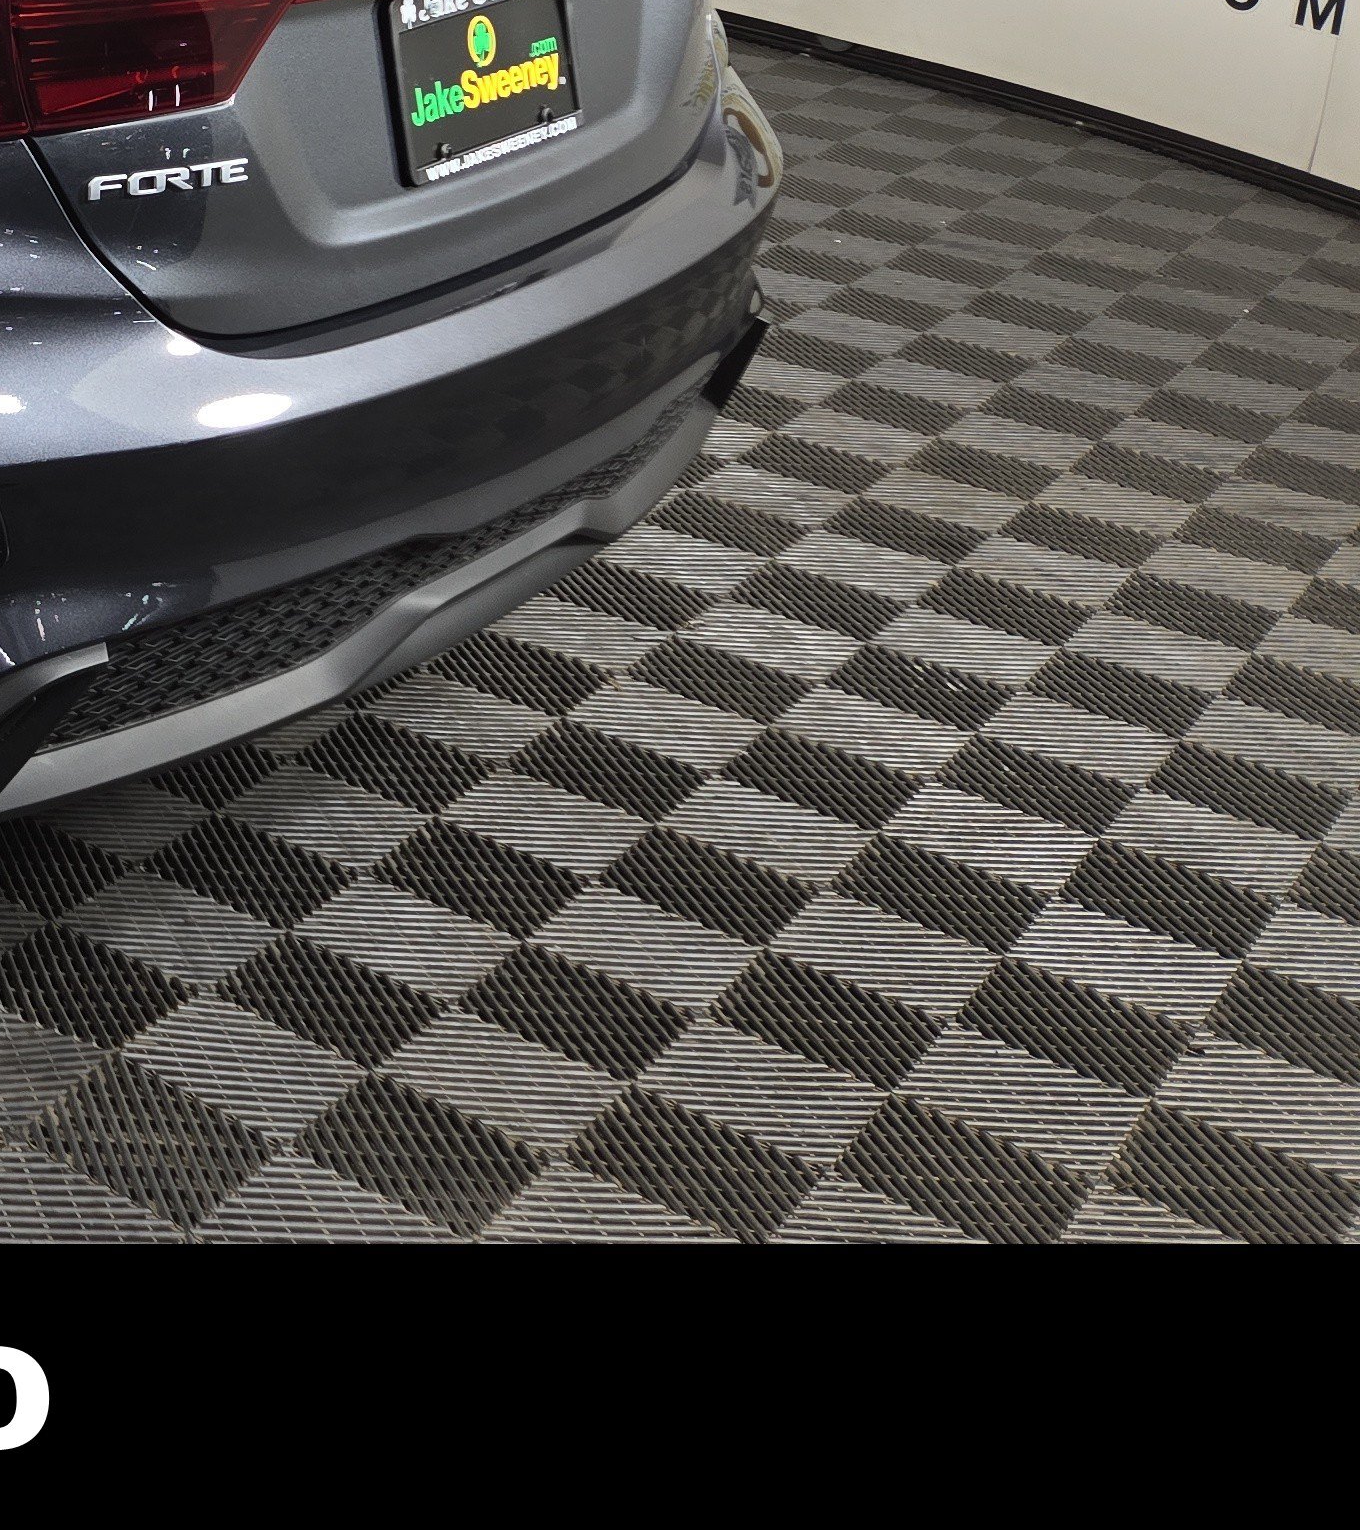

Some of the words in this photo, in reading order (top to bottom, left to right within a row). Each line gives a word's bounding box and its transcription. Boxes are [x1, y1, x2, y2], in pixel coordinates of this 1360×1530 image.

[529, 36, 558, 58] .com
[411, 52, 560, 127] JakeSweeney
[87, 157, 249, 201] FORTE
